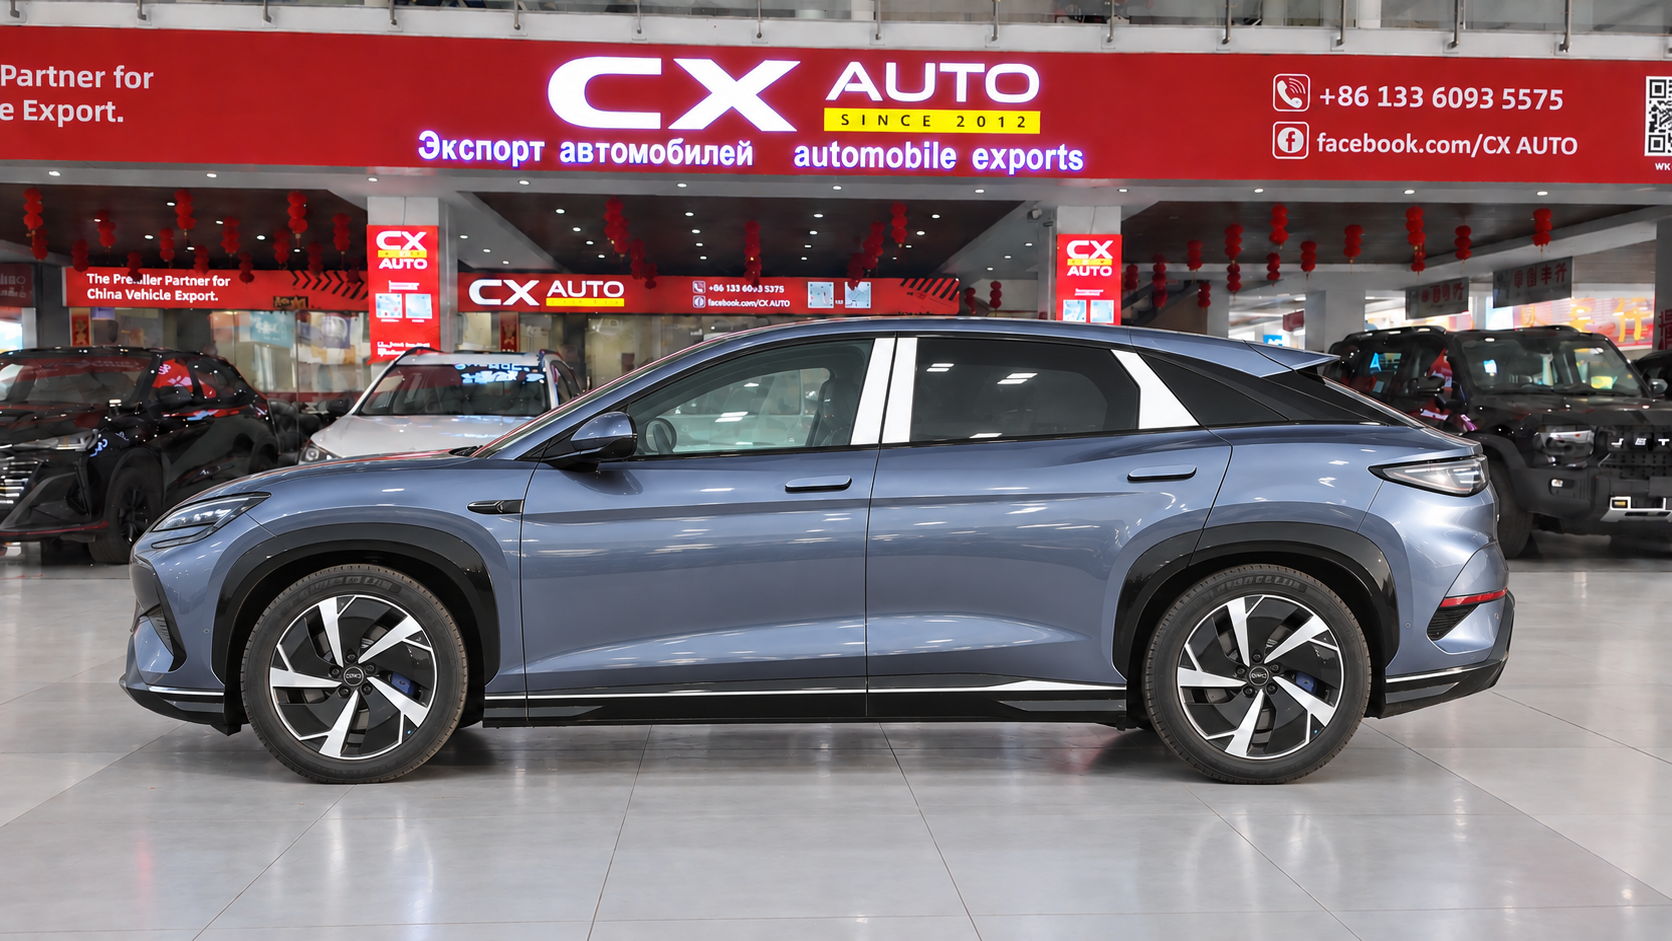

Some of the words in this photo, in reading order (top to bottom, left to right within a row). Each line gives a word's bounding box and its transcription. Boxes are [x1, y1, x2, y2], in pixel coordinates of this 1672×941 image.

[0, 64, 106, 88] Partner
[114, 64, 154, 89] for
[826, 62, 1040, 104] AUTO
[548, 57, 800, 132] CX
[1320, 85, 1368, 107] +86
[1378, 85, 1424, 108] 133
[1432, 87, 1494, 109] 6093
[1503, 88, 1563, 111] 5575
[23, 100, 124, 128] Export.
[841, 113, 931, 127] SINCE
[956, 115, 1026, 128] 2012
[418, 131, 545, 168] Экспорт
[560, 137, 753, 167] автомобилей
[1317, 132, 1511, 158] facebook.com/CX
[1516, 136, 1578, 155] AUTO
[794, 140, 957, 170] automobile
[973, 144, 1084, 175] exports
[376, 230, 427, 251] CX
[1066, 239, 1114, 259] CX
[378, 258, 428, 270] AUTO
[1066, 265, 1113, 277] AUTO
[87, 273, 110, 285] The
[165, 276, 210, 287] Partner
[212, 275, 231, 287] for
[547, 280, 625, 297] AUTO
[727, 284, 740, 293] 133
[87, 287, 123, 300] China
[125, 288, 172, 301] Vehicle
[175, 289, 219, 304] Export.
[468, 279, 540, 306] CX
[769, 299, 791, 308] AUTO
